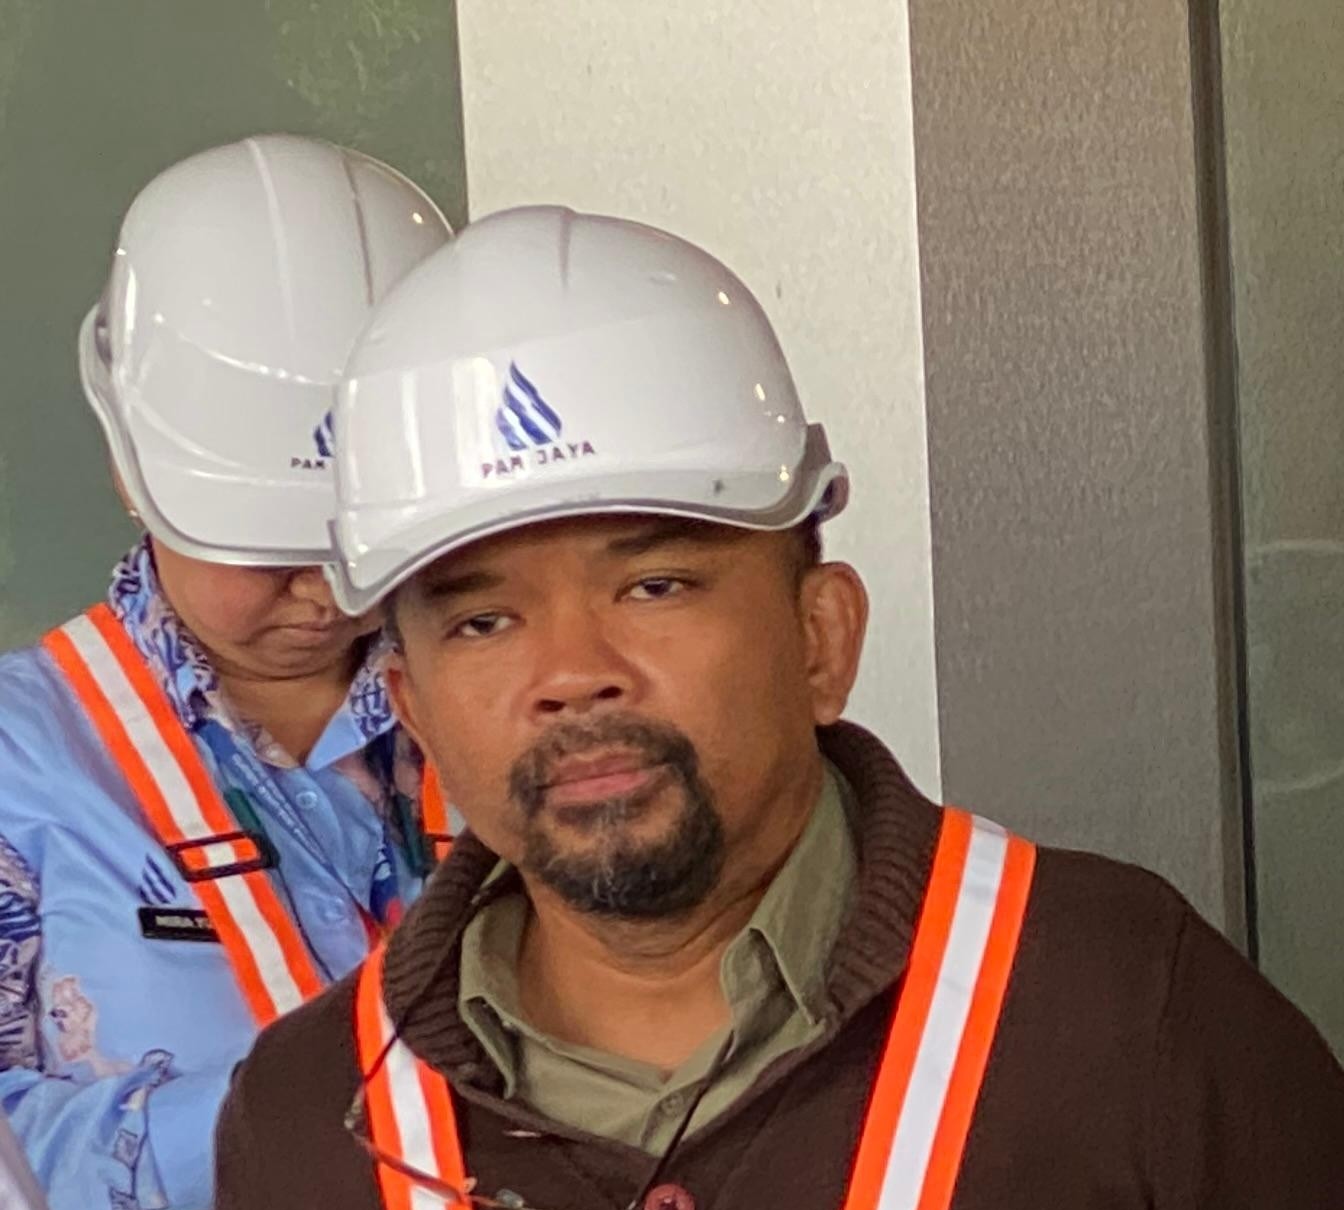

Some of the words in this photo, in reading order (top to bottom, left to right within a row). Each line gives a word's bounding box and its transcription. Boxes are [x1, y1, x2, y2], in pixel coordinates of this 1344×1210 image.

[290, 457, 325, 470] PAM
[481, 456, 524, 478] PAM
[536, 440, 596, 465] JAYA
